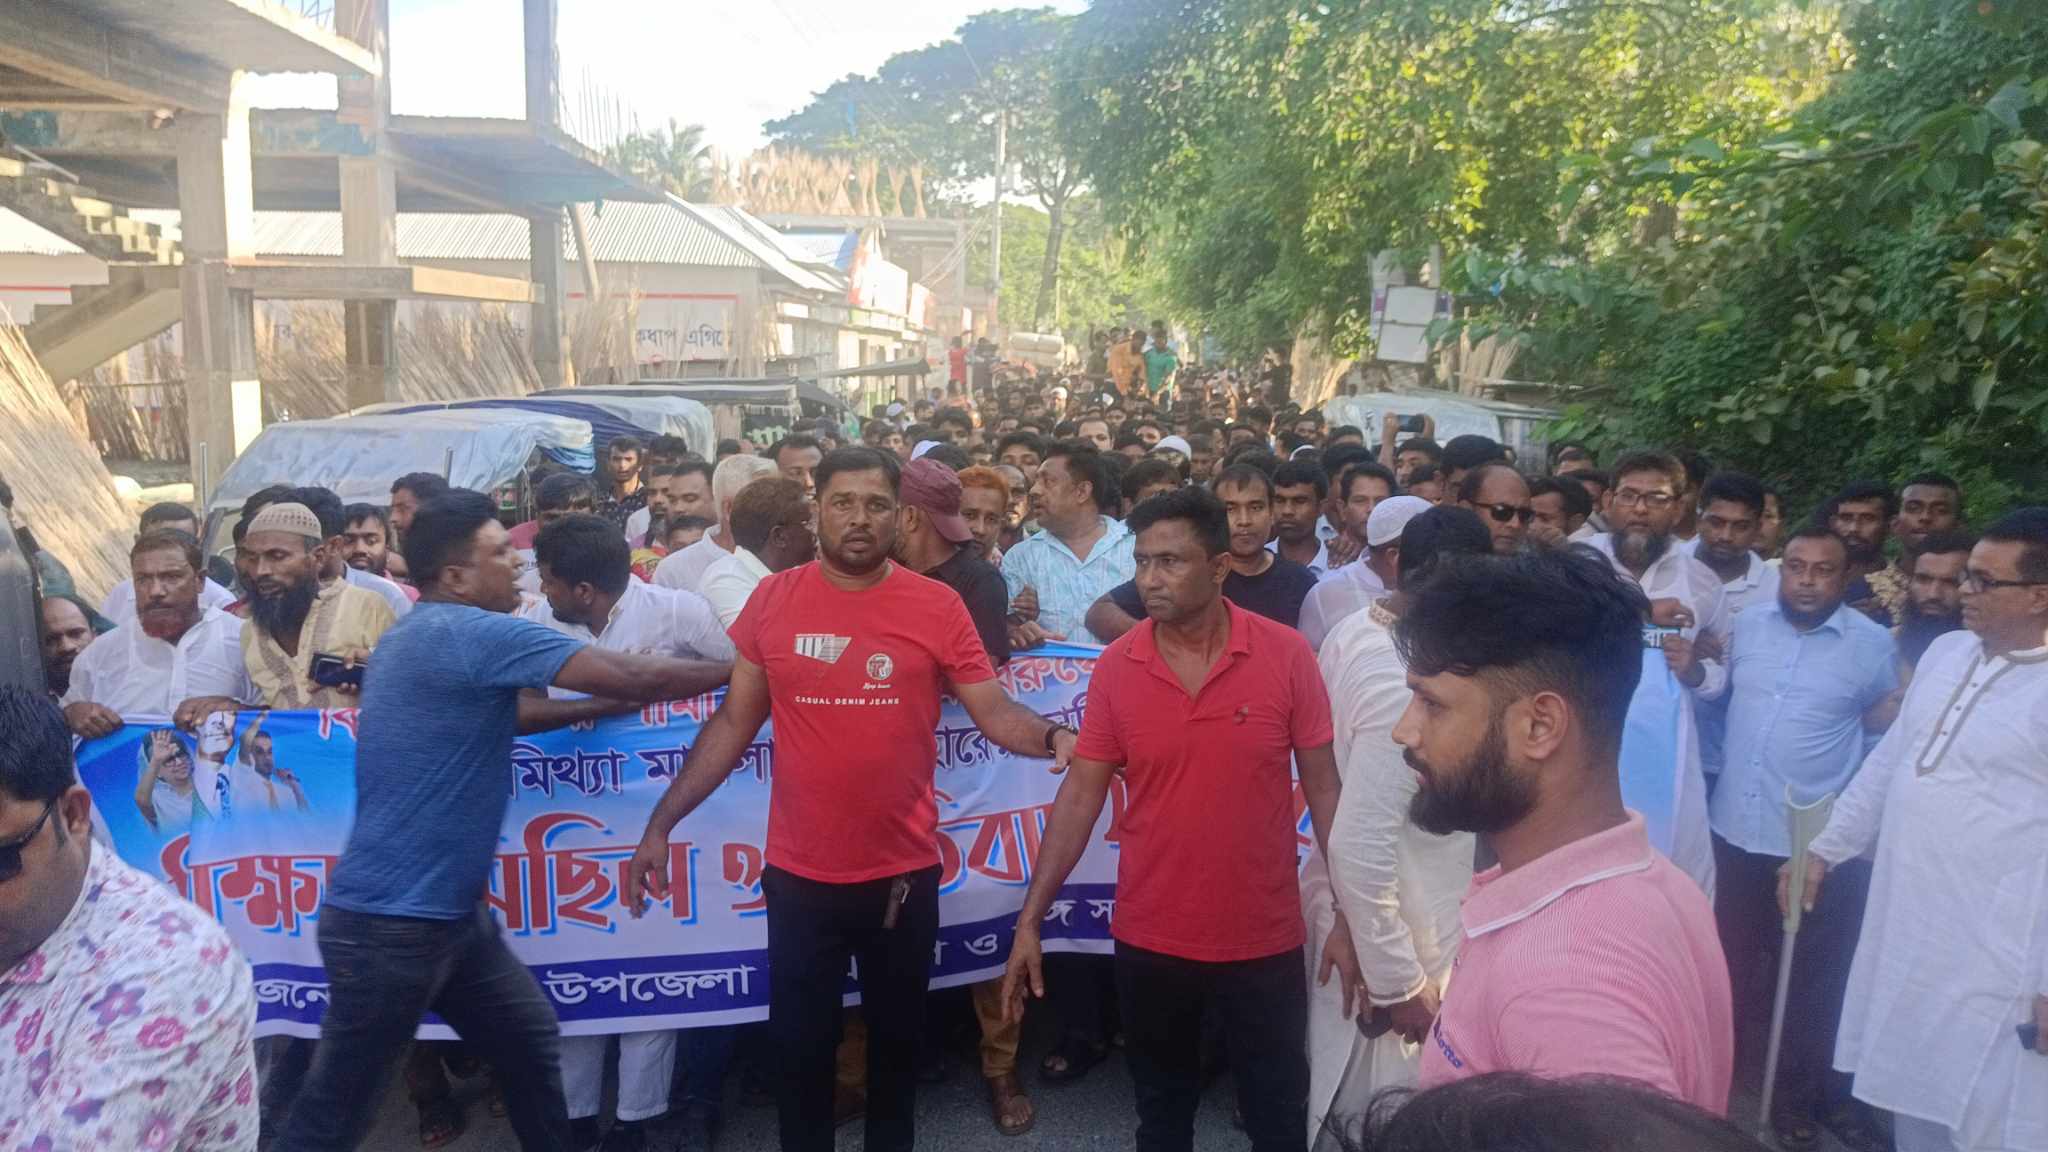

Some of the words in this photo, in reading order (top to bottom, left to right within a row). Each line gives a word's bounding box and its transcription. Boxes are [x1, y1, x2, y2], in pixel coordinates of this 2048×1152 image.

[795, 696, 831, 705] CASUAL
[542, 963, 758, 1005] উপজেলা
[963, 933, 999, 956] ও
